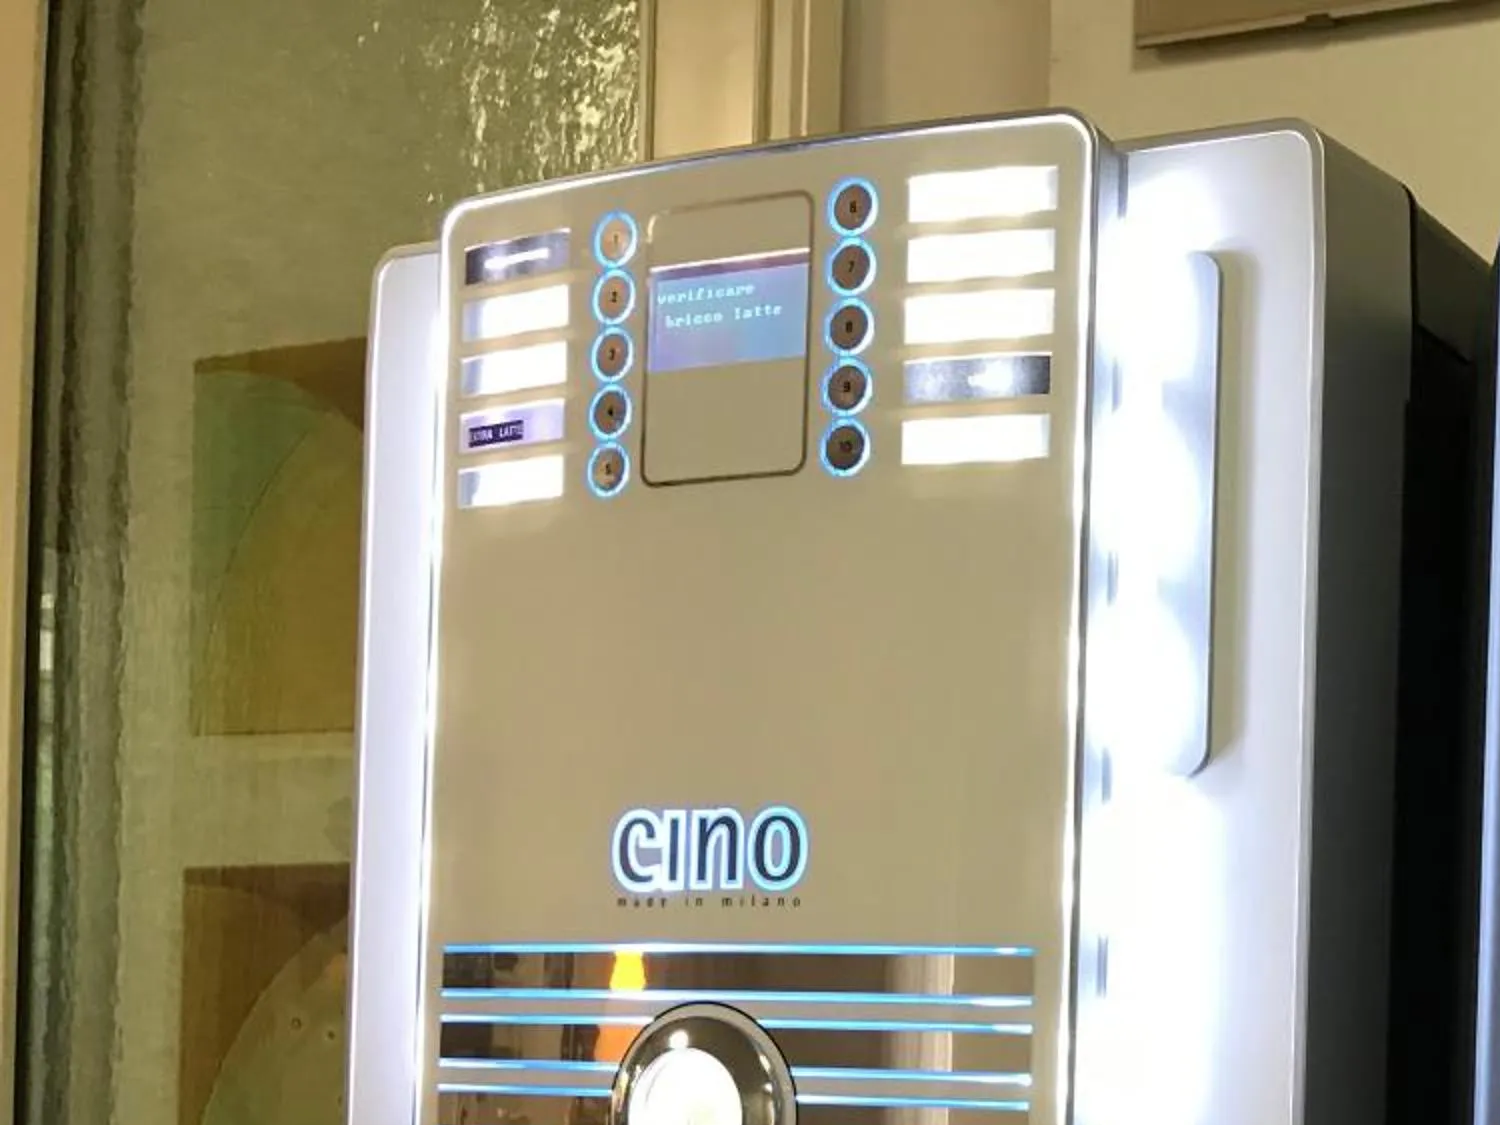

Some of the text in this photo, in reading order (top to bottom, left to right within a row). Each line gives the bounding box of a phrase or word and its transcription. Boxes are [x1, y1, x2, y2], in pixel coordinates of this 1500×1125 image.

[657, 284, 755, 305] verificare
[734, 304, 782, 320] latte
[612, 806, 808, 892] cino
[721, 893, 801, 908] milano
